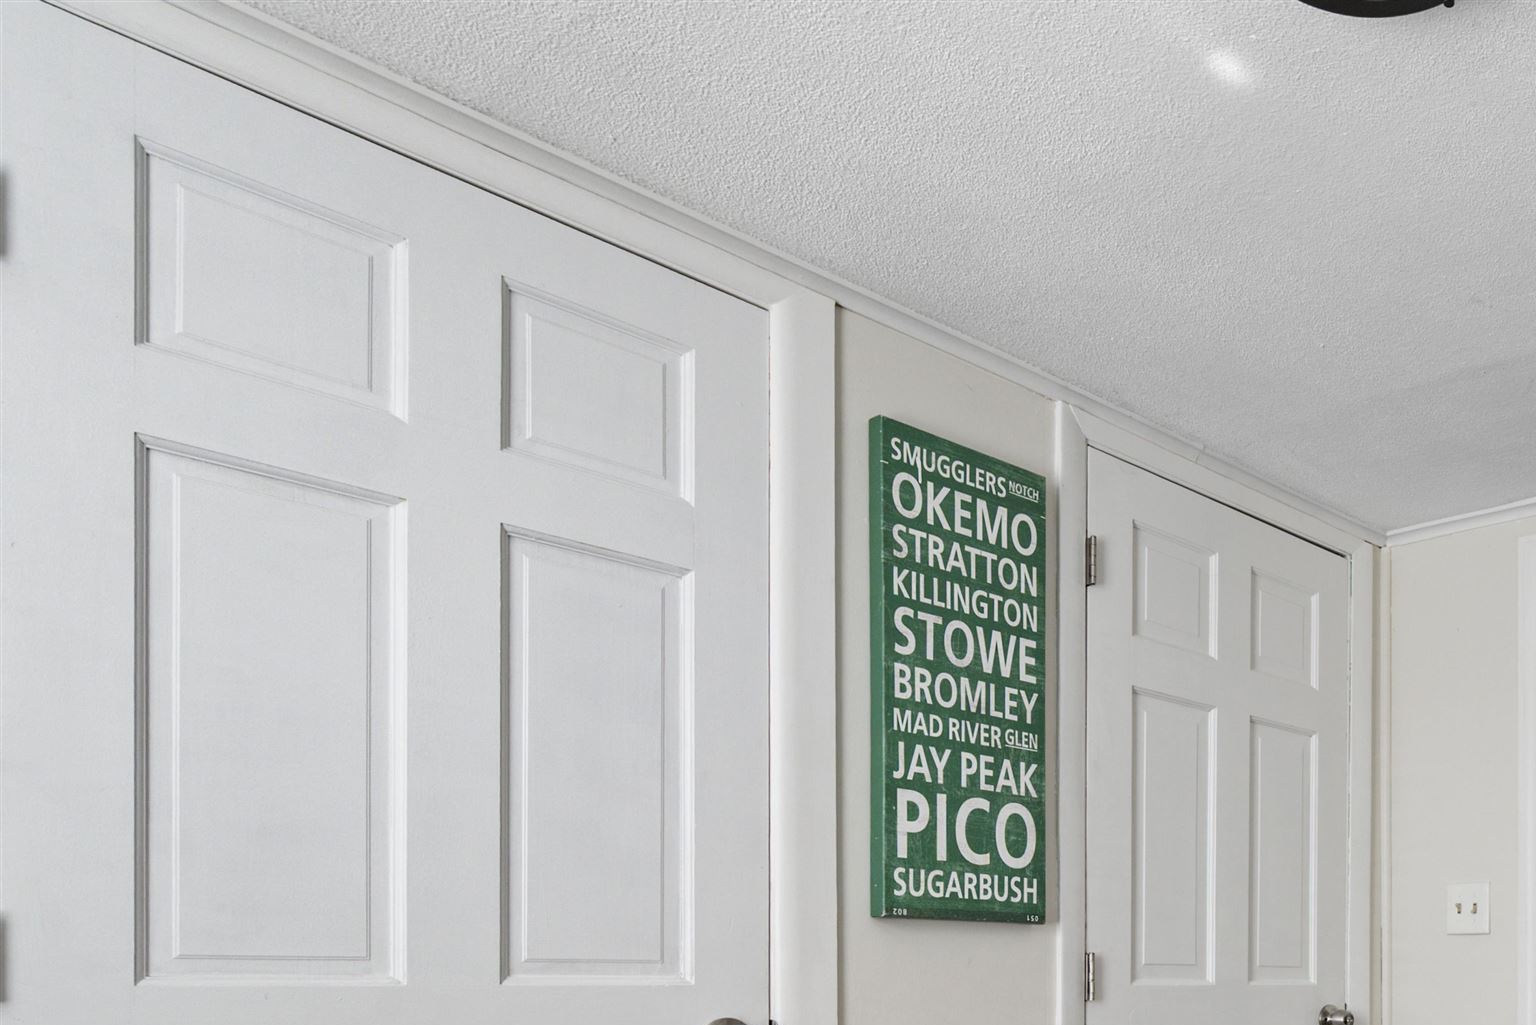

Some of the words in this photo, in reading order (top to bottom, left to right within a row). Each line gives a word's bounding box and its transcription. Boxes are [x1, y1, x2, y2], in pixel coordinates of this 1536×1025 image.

[890, 437, 1007, 498] SMUGGLERS
[1009, 480, 1039, 500] NOTCH
[892, 472, 1038, 556] OKEMO
[892, 524, 1038, 598] STRATTON
[893, 566, 1038, 633] KILLINGTON
[894, 606, 1037, 684] STOWE
[894, 663, 1039, 725] BROMLEY
[893, 707, 943, 738] MAD
[949, 718, 1002, 749] RIVER
[1005, 728, 1038, 750] GLEN
[892, 741, 952, 785] JAY
[960, 751, 1038, 798] PEAK
[896, 788, 1037, 869] PICO
[893, 867, 1038, 904] SUGARBUSH
